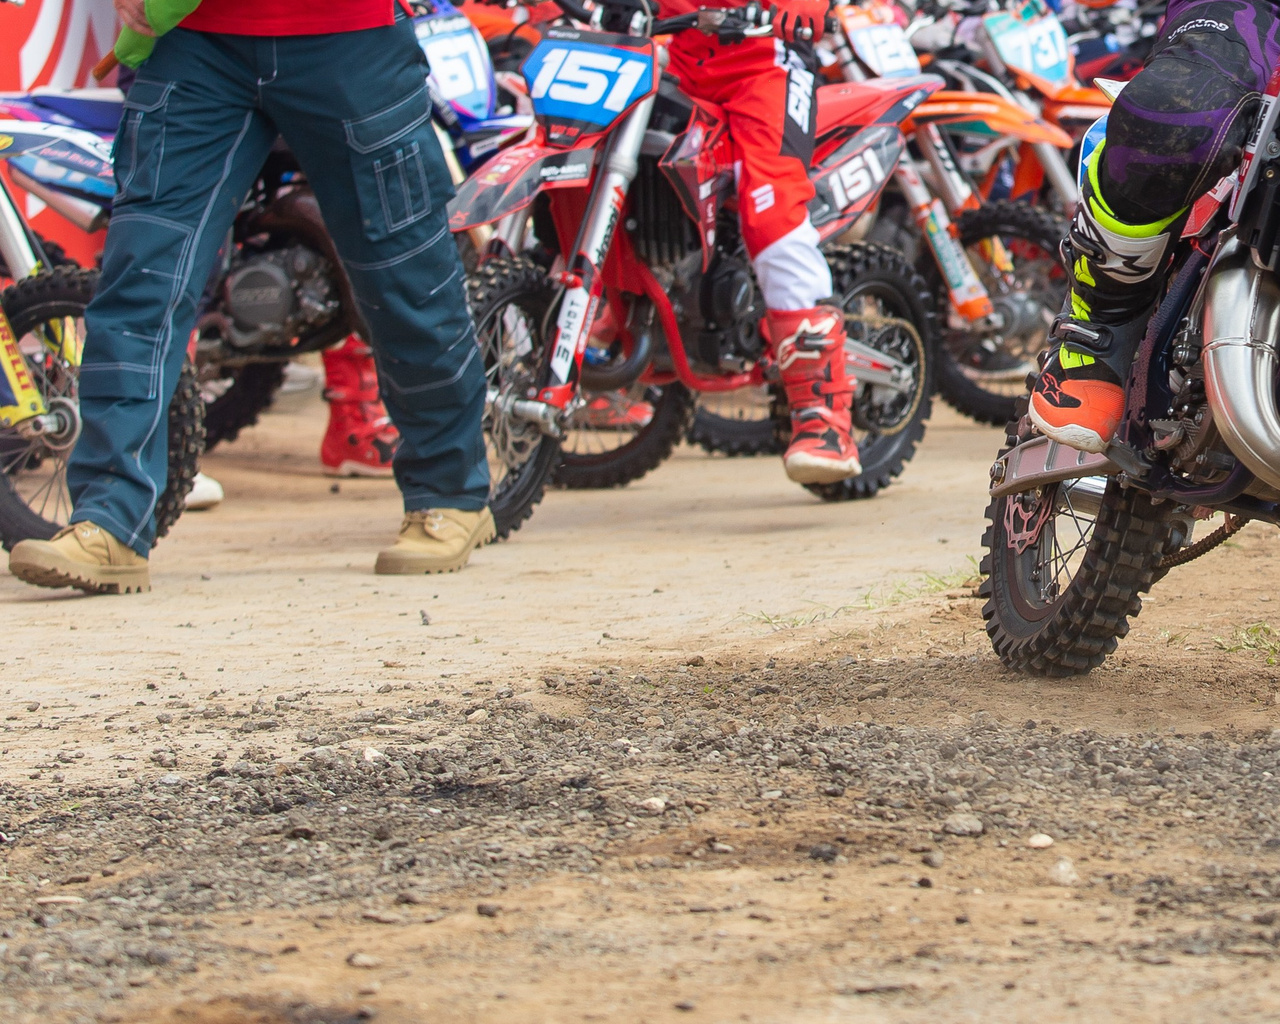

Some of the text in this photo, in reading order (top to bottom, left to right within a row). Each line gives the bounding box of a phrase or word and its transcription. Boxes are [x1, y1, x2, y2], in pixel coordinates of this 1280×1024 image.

[531, 48, 647, 113] 151
[829, 148, 885, 209] 151
[0, 305, 31, 390] IRELLI
[560, 299, 581, 341] SHOT
